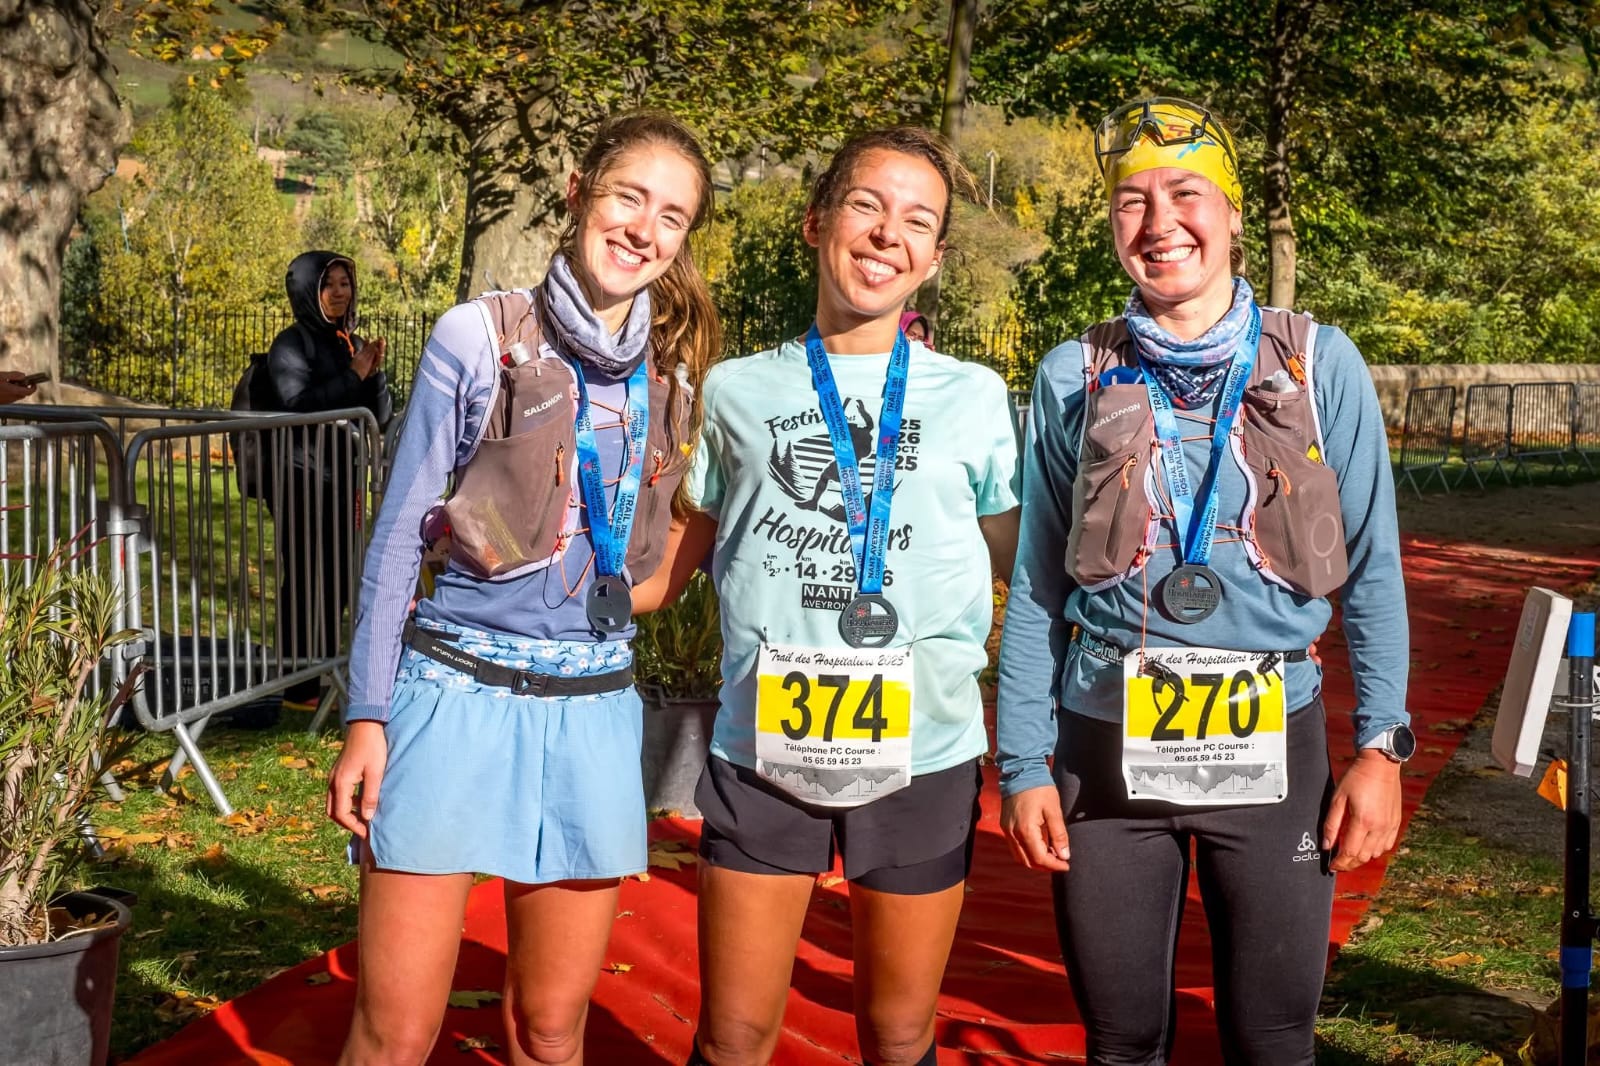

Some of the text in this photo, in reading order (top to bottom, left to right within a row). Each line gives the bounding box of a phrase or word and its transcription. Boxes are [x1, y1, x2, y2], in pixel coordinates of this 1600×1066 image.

[524, 392, 563, 418] SALOMON
[887, 390, 896, 412] TRAIL
[1150, 386, 1162, 412] TRAIL
[1219, 365, 1240, 419] HOSPITALIERS
[764, 408, 824, 438] Festiv
[900, 419, 920, 430] 25
[1093, 403, 1141, 430] SALOMON
[898, 432, 920, 444] 26
[878, 460, 886, 491] FESTIVAL
[884, 435, 896, 491] HOSPITALIERS
[895, 455, 918, 471] 25
[1171, 435, 1188, 496] HOSPITALIERS
[846, 465, 862, 512] FESTIVAL DES
[1171, 467, 1181, 497] FESTIVAL
[840, 467, 858, 527] HOSPITALIERS
[614, 494, 626, 539] HOSPITALIERS
[620, 494, 635, 538] TRAIL DES
[752, 506, 913, 560] Hospitars
[867, 518, 880, 579] NANT-AVEYRON
[795, 562, 817, 579] 14
[831, 565, 856, 583] 29
[803, 600, 848, 610] AVEYRON
[804, 584, 850, 600] NANT
[770, 649, 793, 662] Trail
[795, 653, 811, 664] des
[878, 655, 904, 666] 2025
[1166, 654, 1182, 664] des
[1185, 652, 1247, 667] Hospitaliers
[781, 671, 888, 742] 374
[1151, 670, 1260, 741] 270
[785, 743, 828, 755] Téléphone
[830, 747, 843, 755] PC
[845, 747, 876, 755] Course
[1156, 744, 1200, 754] Téléphone
[1203, 743, 1215, 751] PC
[1218, 742, 1249, 751] Course
[1293, 851, 1320, 861] odlo
